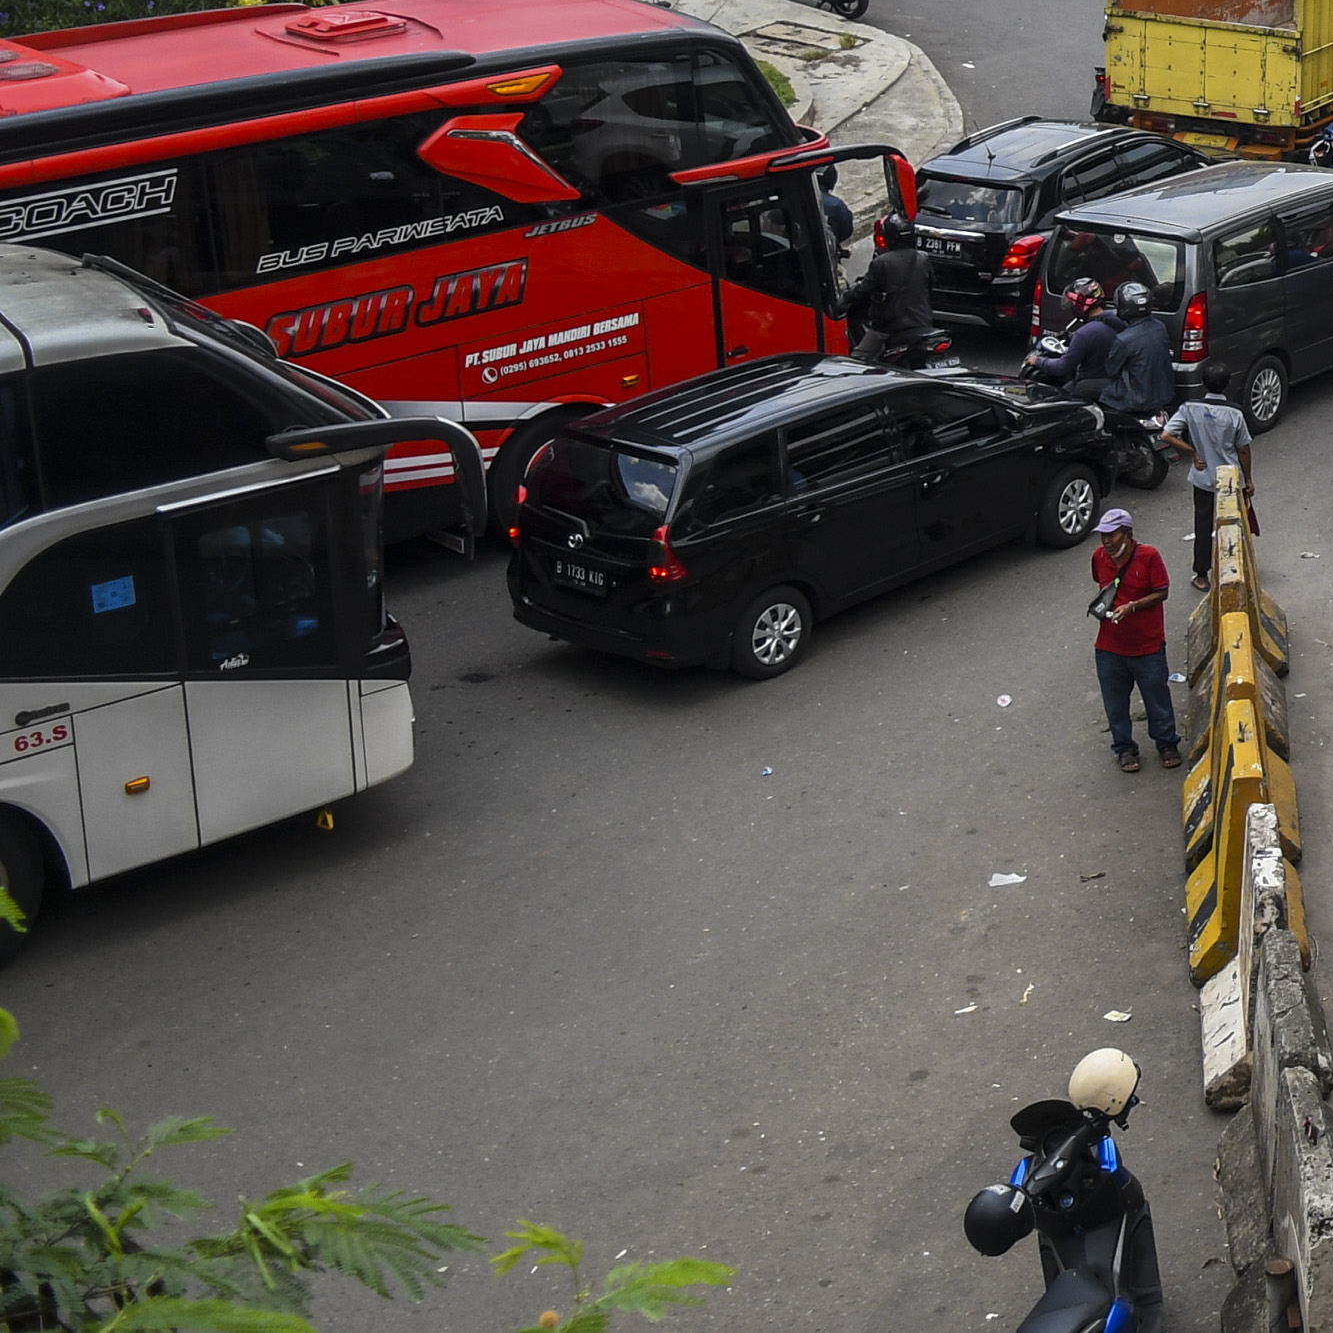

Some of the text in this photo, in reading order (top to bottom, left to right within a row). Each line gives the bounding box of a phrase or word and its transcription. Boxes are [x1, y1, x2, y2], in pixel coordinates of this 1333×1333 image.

[255, 205, 504, 275] BUS PARIWISATA
[524, 213, 598, 238] JETBUS
[917, 237, 922, 247] B
[264, 257, 529, 360] SUBUR JAYA
[482, 341, 517, 366] SUBUR
[519, 335, 546, 356] JAYA
[547, 326, 592, 350] MANDIRI
[593, 312, 640, 337] BERSAMA
[500, 335, 628, 377] (0295) 693652, 0813 2533 1555
[557, 561, 562, 573] B
[567, 561, 586, 580] 1733
[13, 724, 68, 753] 63.S
